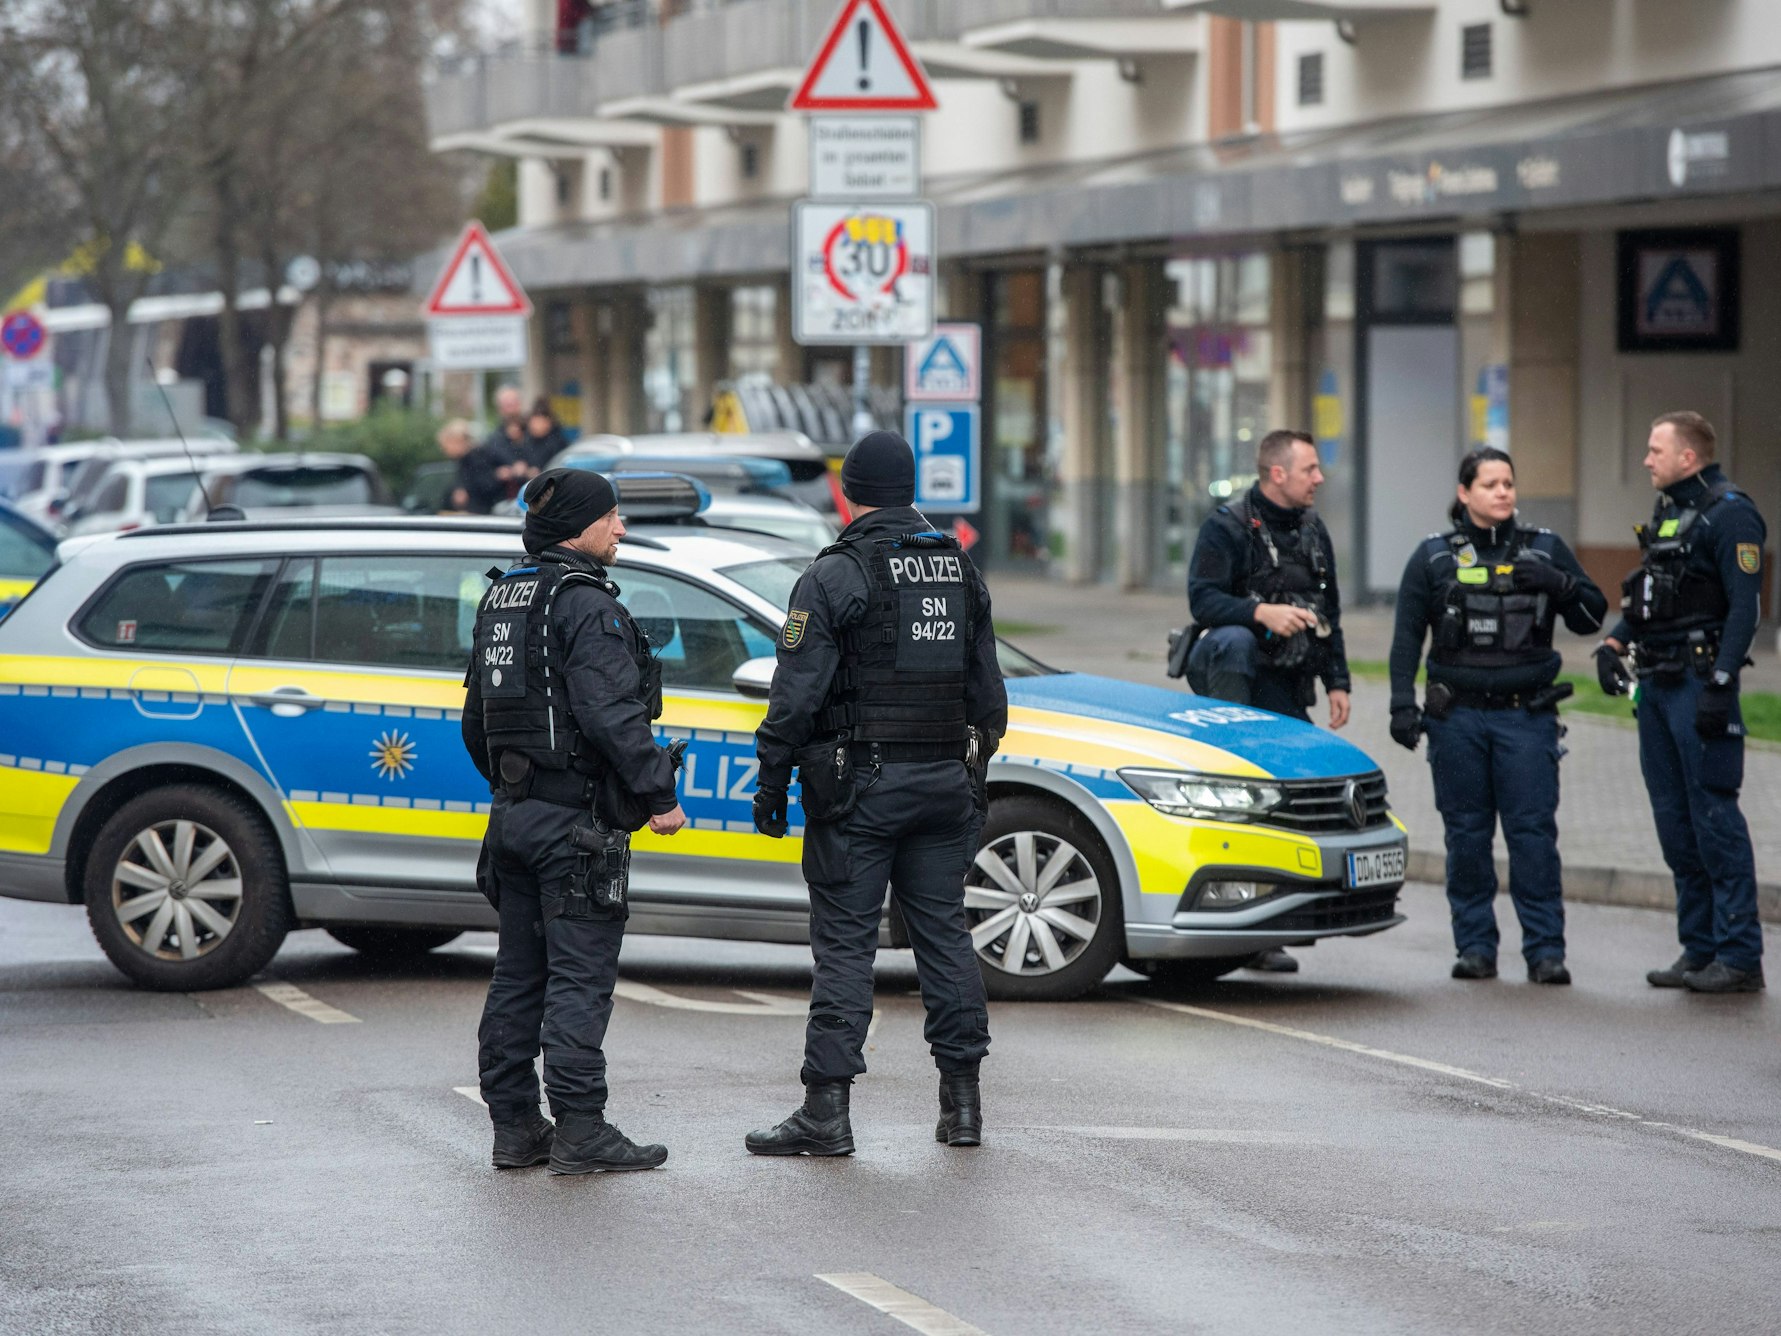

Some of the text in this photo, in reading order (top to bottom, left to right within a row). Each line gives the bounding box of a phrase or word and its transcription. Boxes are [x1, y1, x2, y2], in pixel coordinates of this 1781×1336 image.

[919, 411, 954, 453] P
[888, 556, 963, 583] POLIZEI
[484, 581, 539, 611] POLIZEI
[922, 597, 947, 616] SN
[493, 623, 511, 642] SN
[911, 621, 955, 640] 94/22
[1468, 619, 1499, 633] POLIZEI
[485, 646, 513, 666] 94/22
[1356, 856, 1370, 882] DD
[1375, 854, 1381, 880] Q
